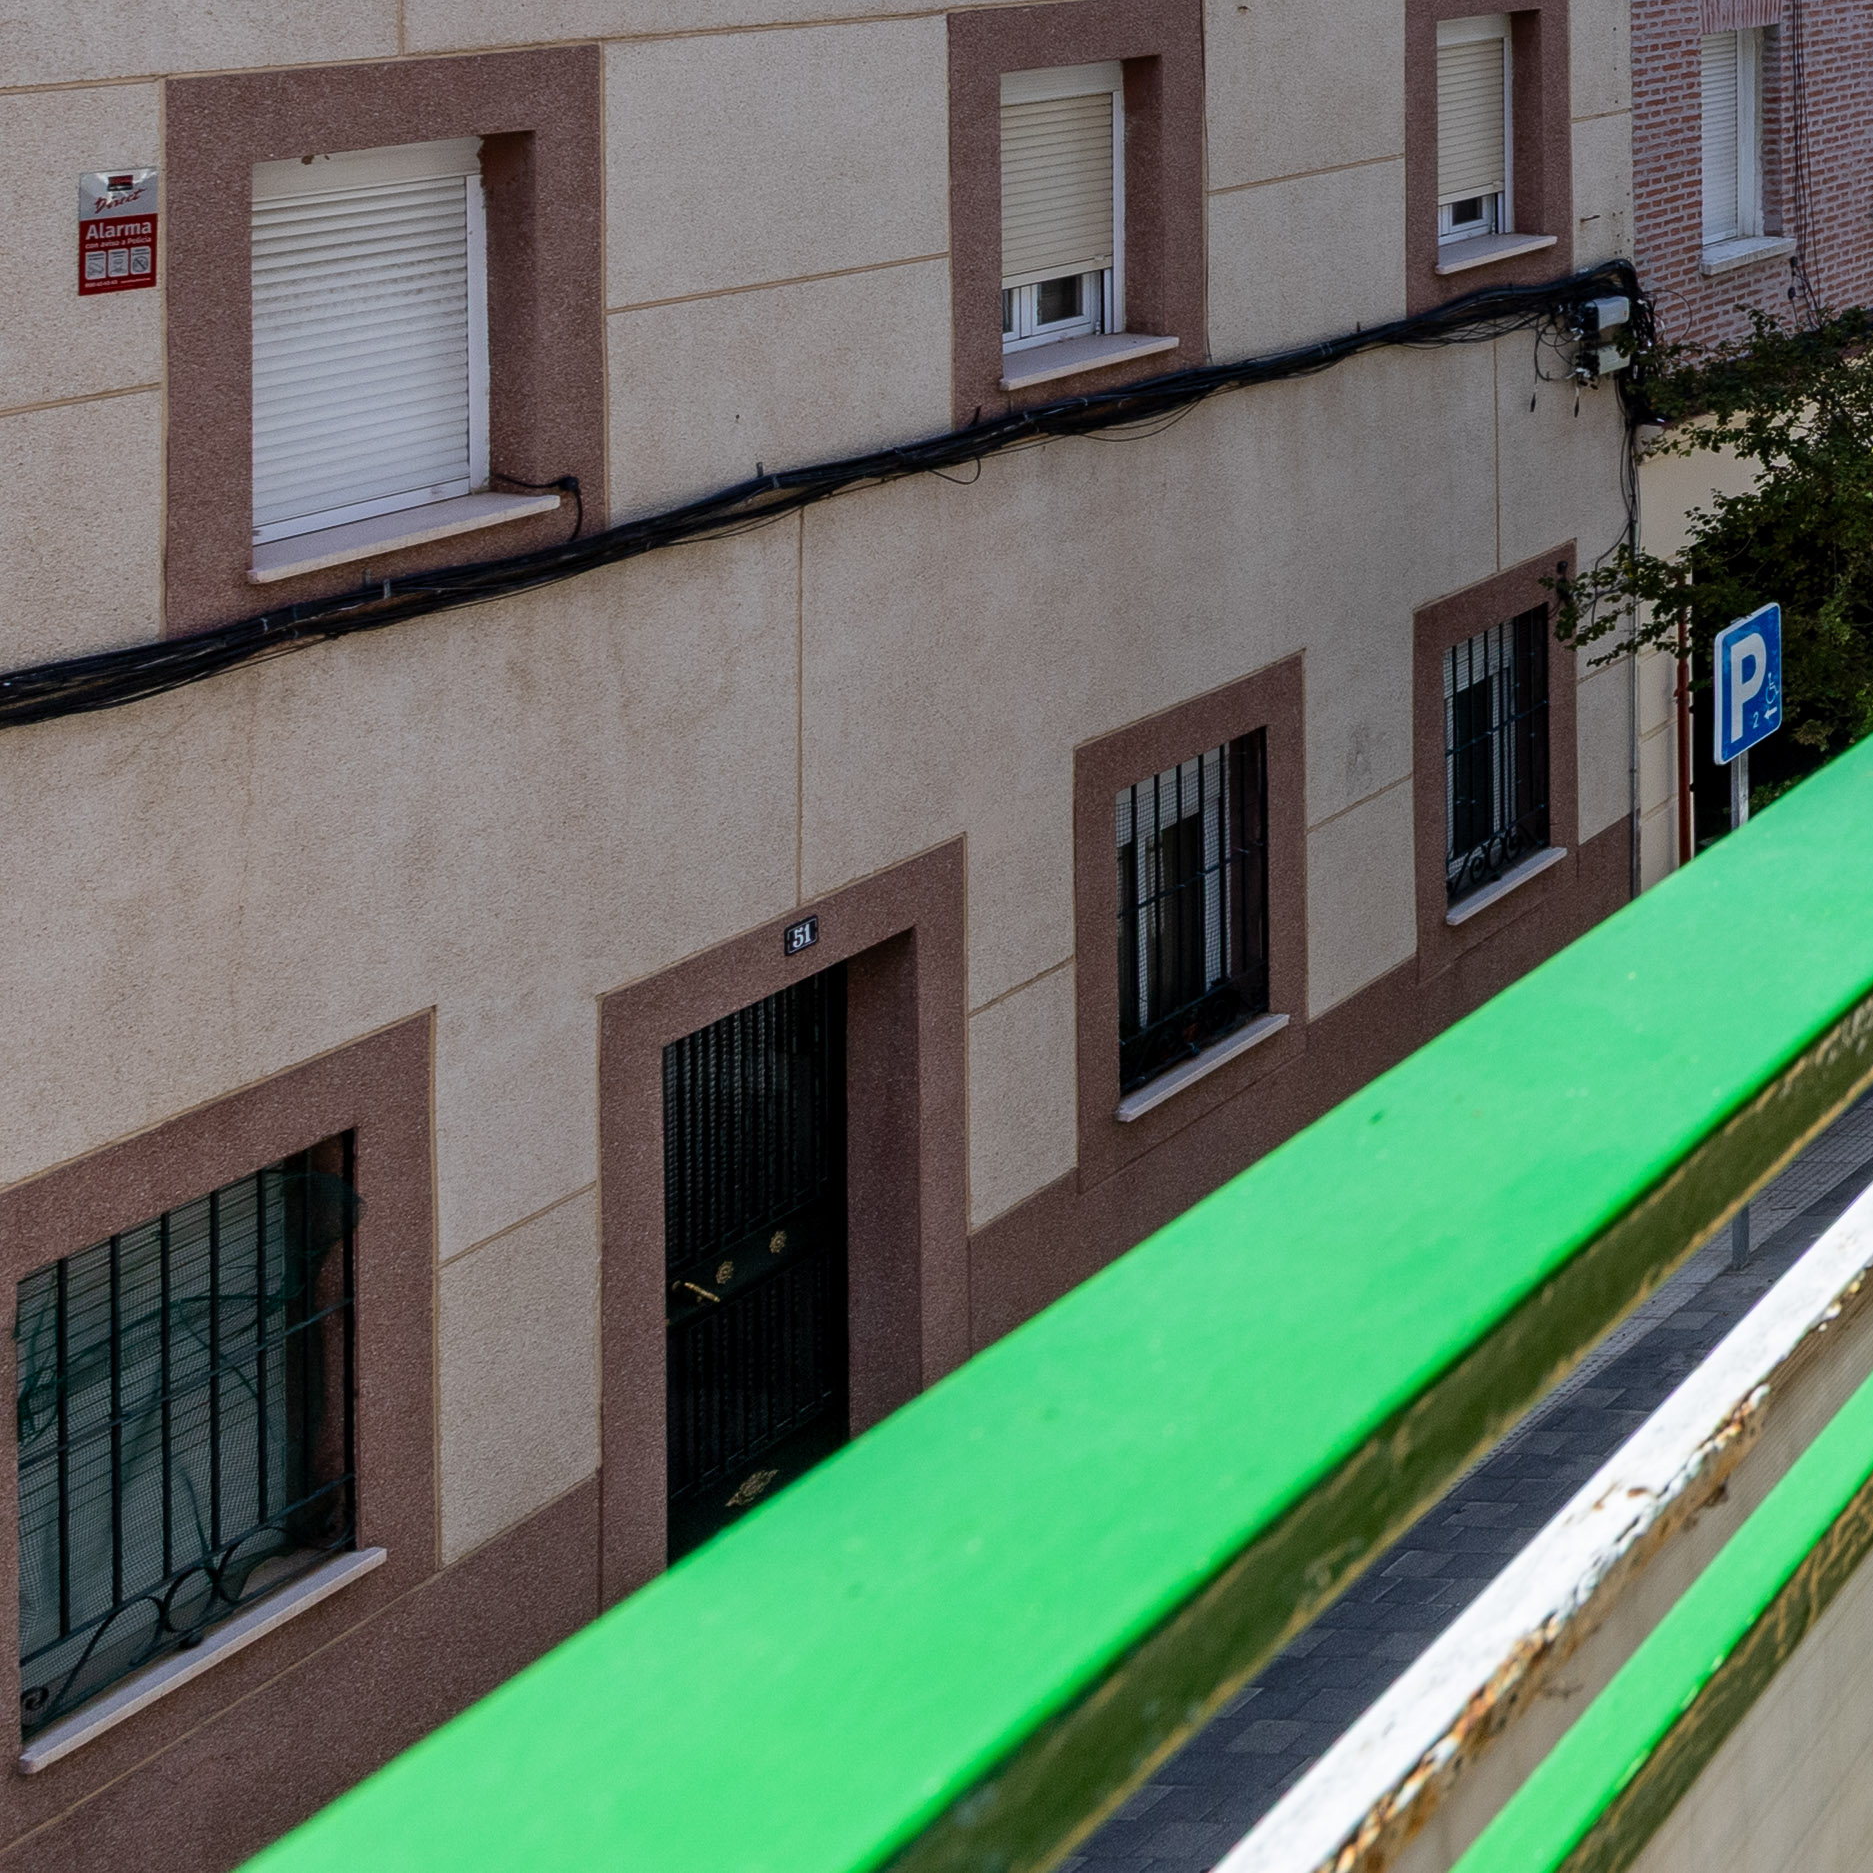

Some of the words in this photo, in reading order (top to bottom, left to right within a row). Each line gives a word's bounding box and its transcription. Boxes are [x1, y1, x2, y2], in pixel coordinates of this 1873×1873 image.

[94, 188, 146, 214] Direct
[86, 222, 152, 240] Alarma
[1731, 632, 1767, 744] P
[1752, 711, 1760, 729] 2
[793, 924, 811, 947] 51
